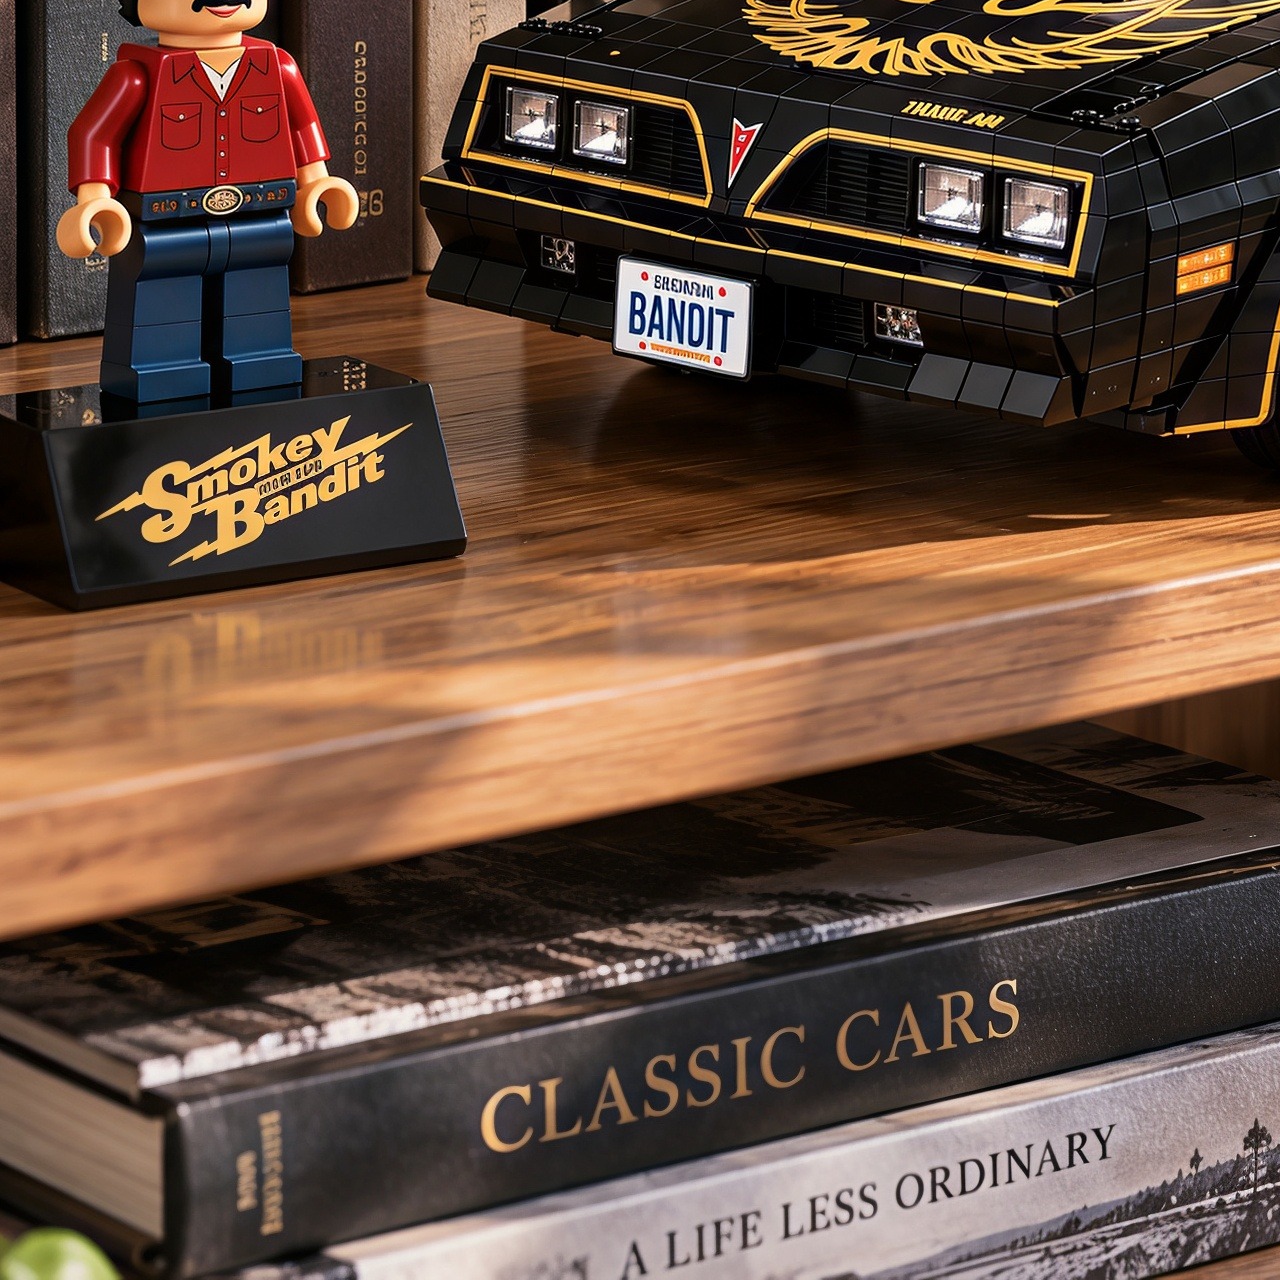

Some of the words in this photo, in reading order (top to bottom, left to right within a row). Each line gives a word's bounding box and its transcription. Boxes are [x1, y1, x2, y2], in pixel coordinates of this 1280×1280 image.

[628, 290, 736, 354] BANDIT
[141, 415, 351, 543] Smokey
[204, 451, 385, 556] Bandit
[480, 1026, 807, 1153] CLASSIC
[836, 978, 1021, 1072] CARS
[621, 1240, 648, 1280] A
[667, 1210, 763, 1270] LIFE
[781, 1182, 878, 1241] LESS
[895, 1123, 1117, 1210] ORDINARY
